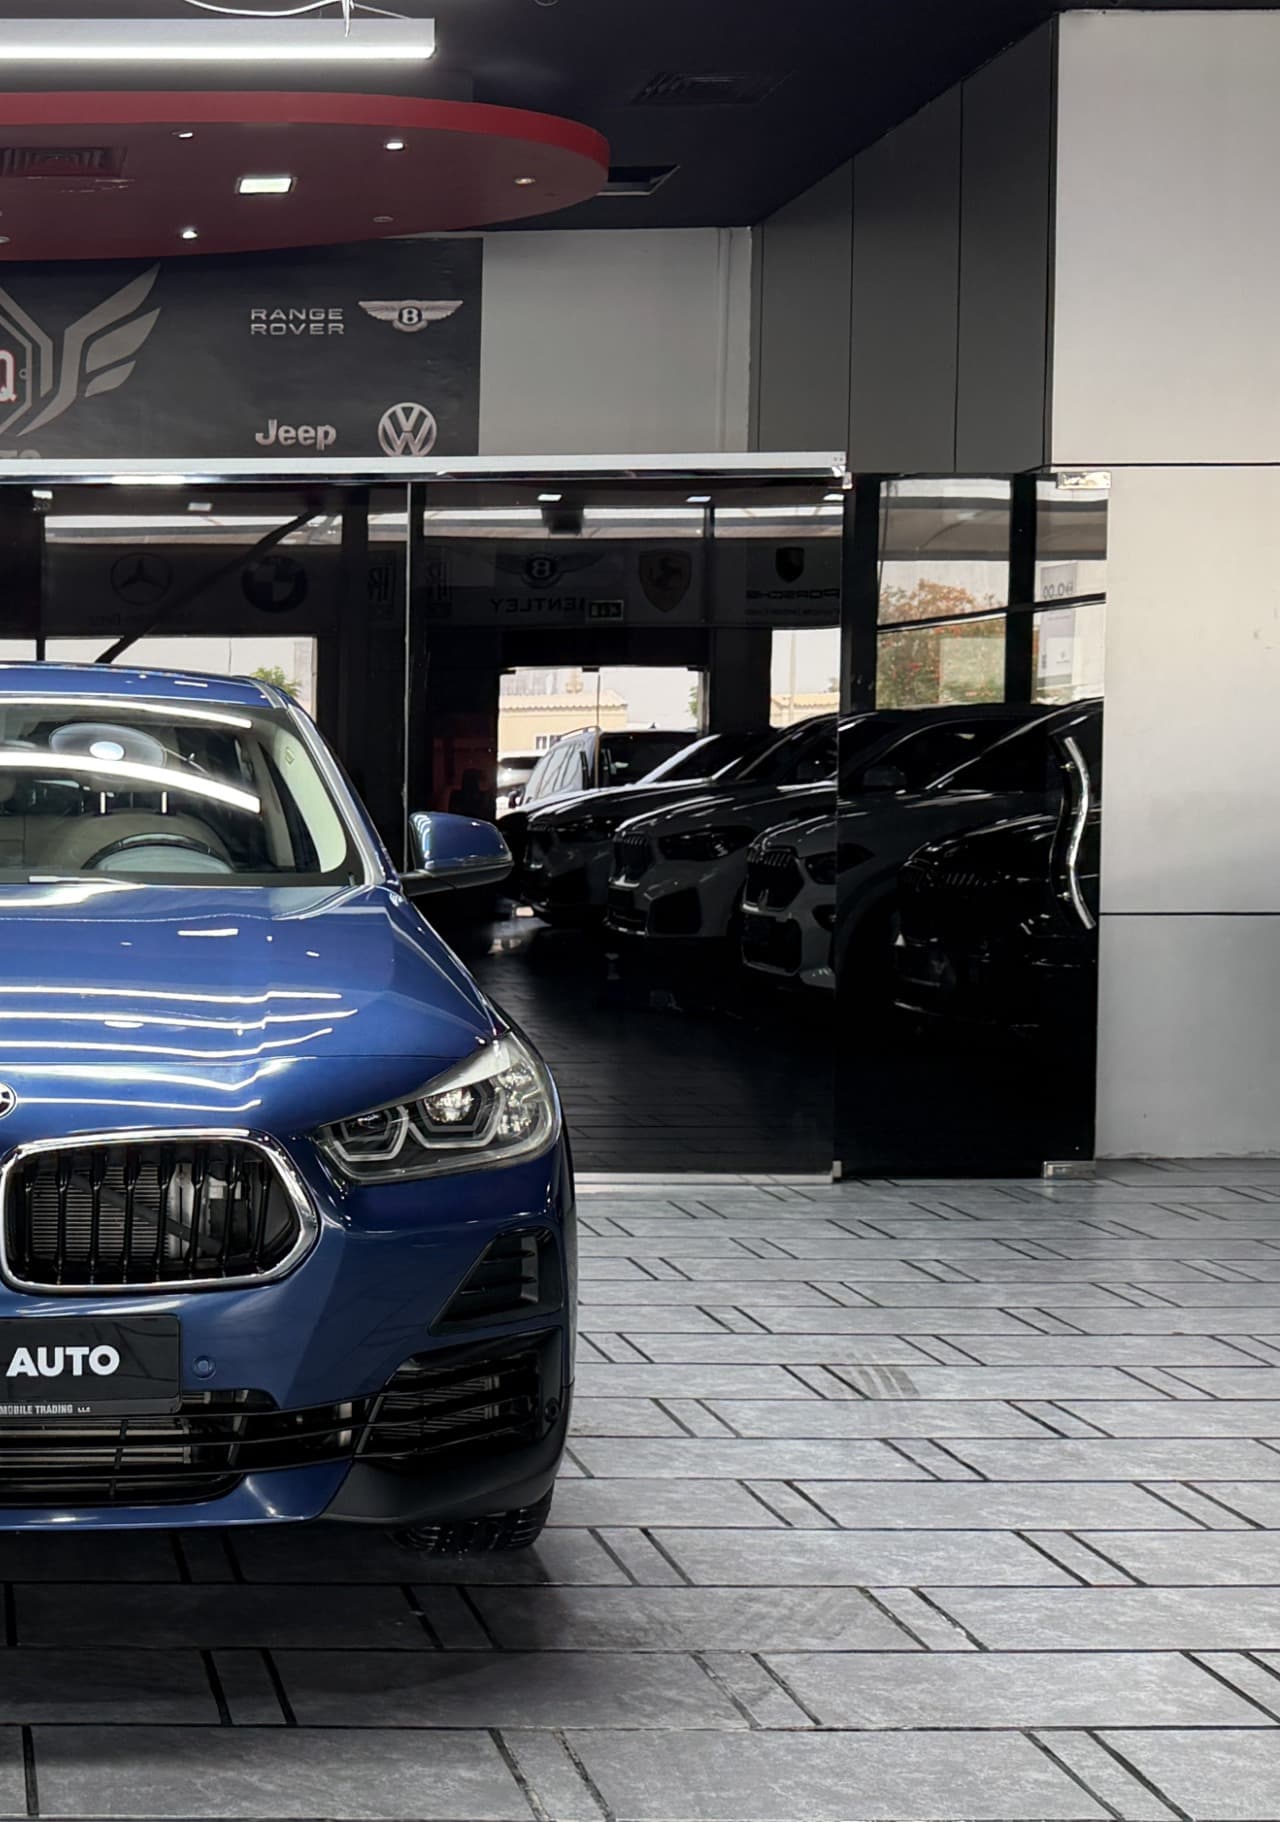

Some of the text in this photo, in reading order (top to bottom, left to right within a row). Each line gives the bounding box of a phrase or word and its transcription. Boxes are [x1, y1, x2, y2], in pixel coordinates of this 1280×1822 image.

[250, 308, 344, 320] RANGE
[250, 322, 345, 335] ROVER
[255, 418, 337, 450] Jeep
[6, 1345, 121, 1378] AUTO
[35, 1404, 73, 1414] TRADING
